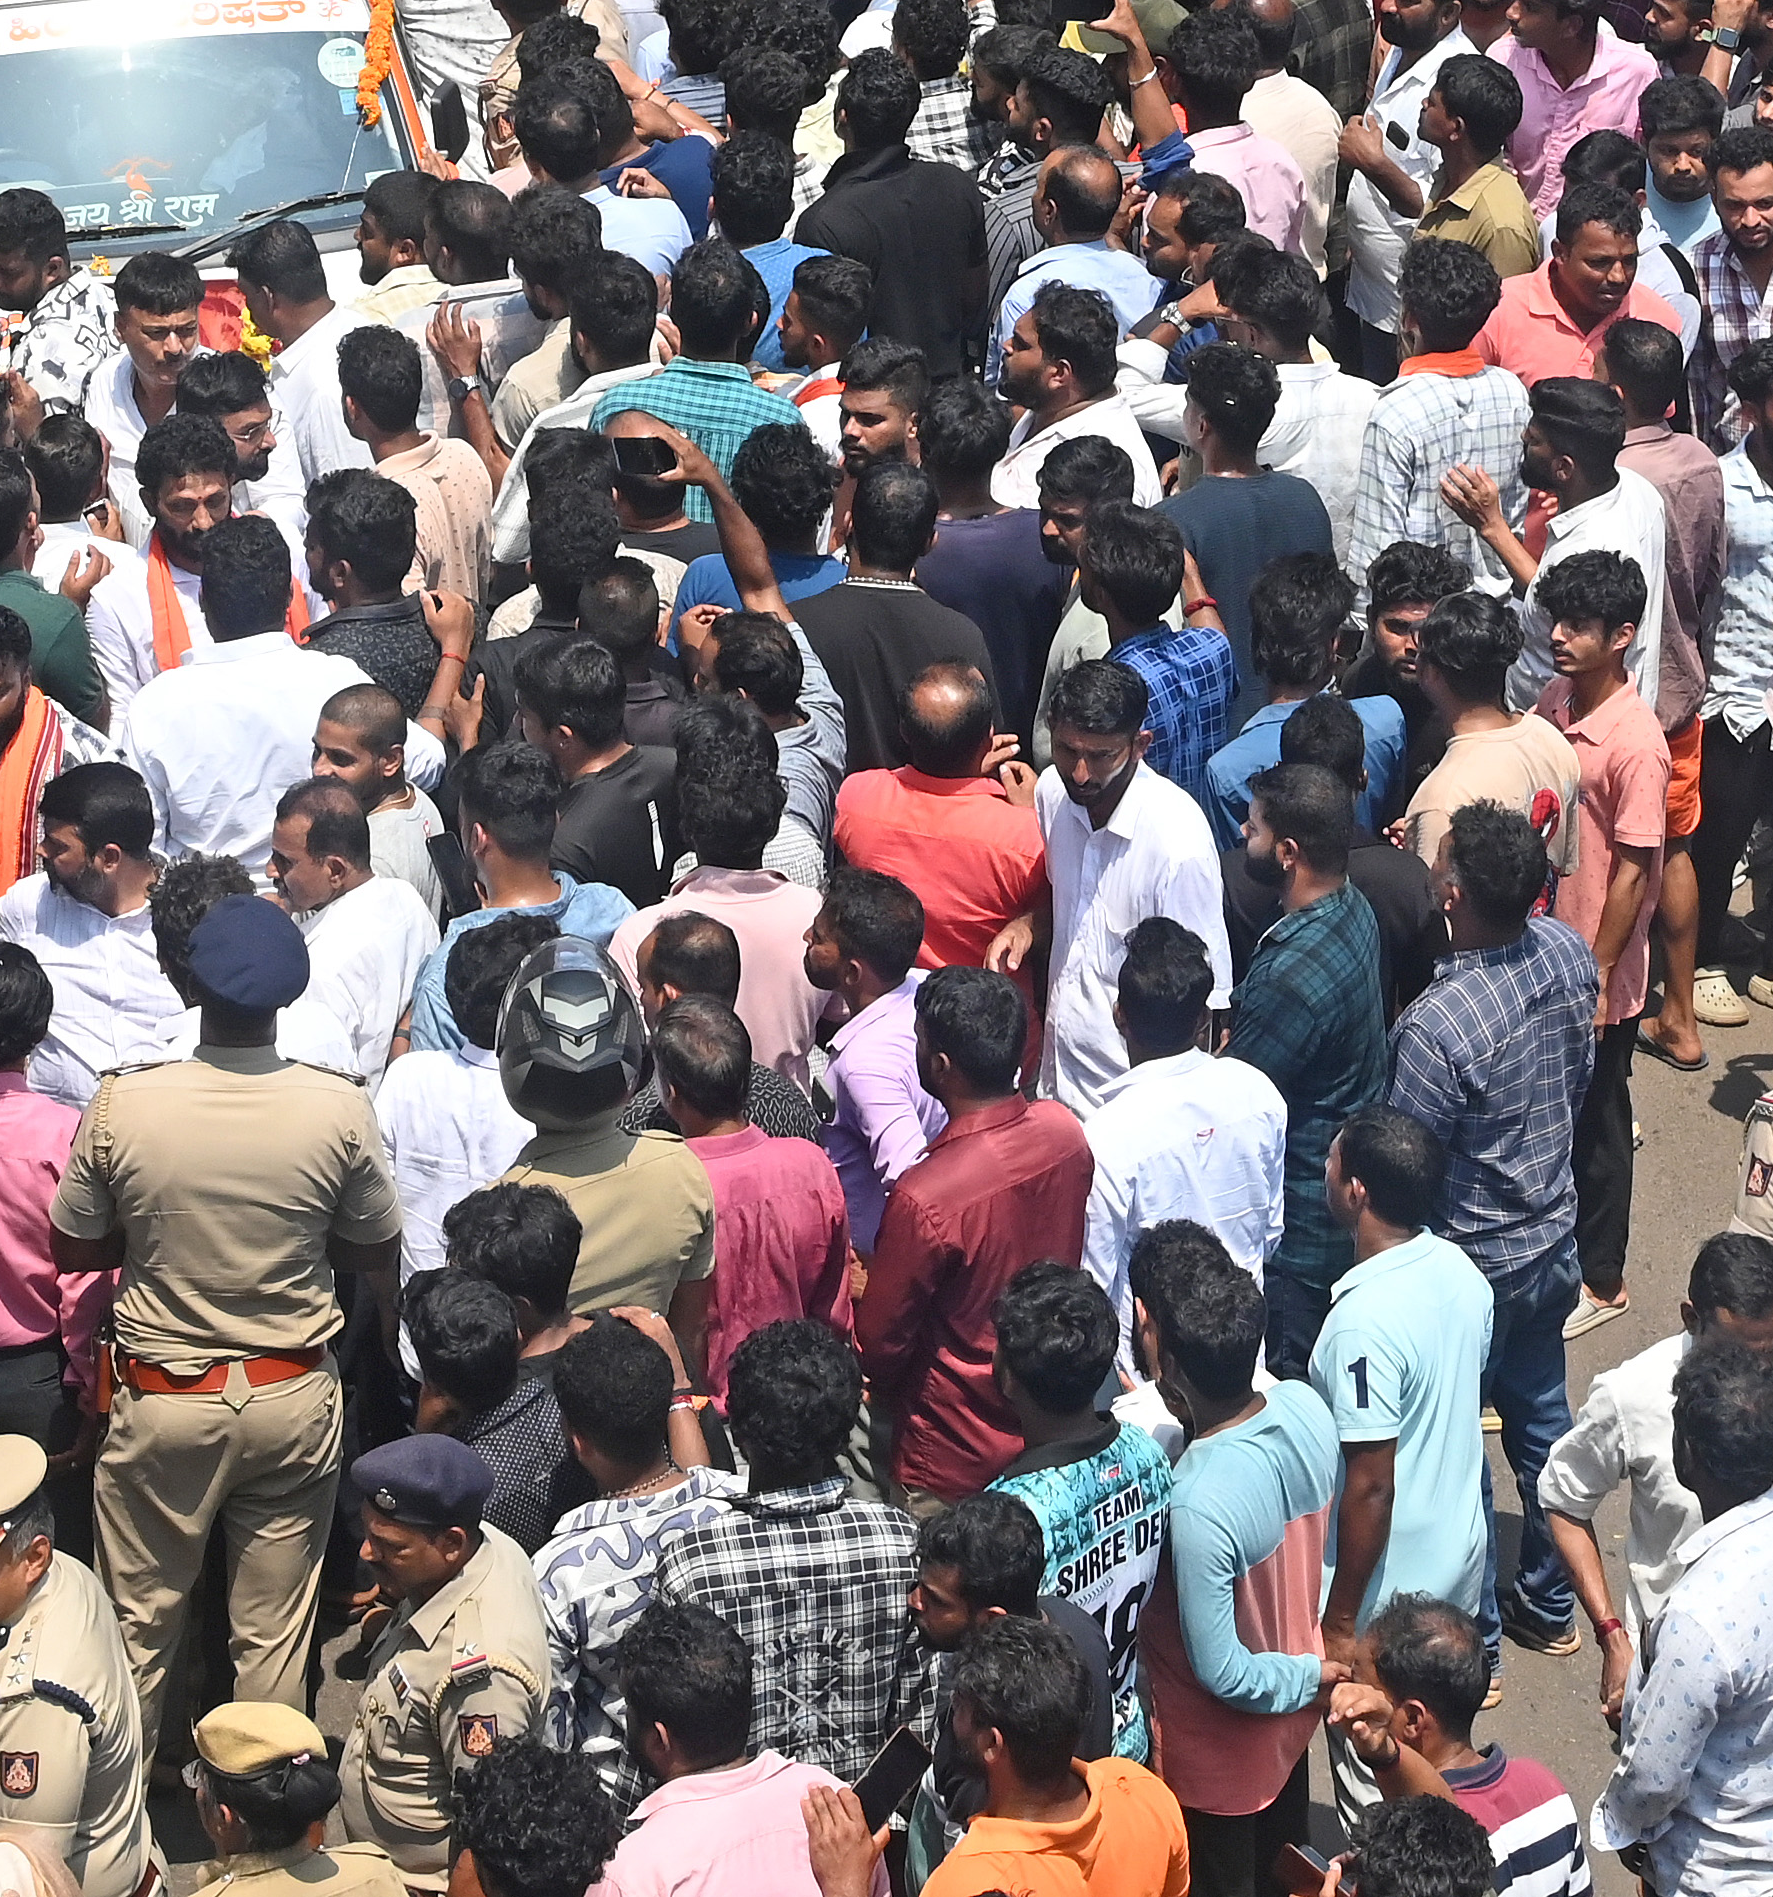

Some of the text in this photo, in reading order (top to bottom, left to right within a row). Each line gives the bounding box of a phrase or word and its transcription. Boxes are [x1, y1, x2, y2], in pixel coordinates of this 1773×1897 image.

[65, 190, 219, 228] जय श्री राम
[1347, 1355, 1370, 1409] 1
[1092, 1486, 1143, 1533] TEAM
[1056, 1529, 1128, 1599] SHREE
